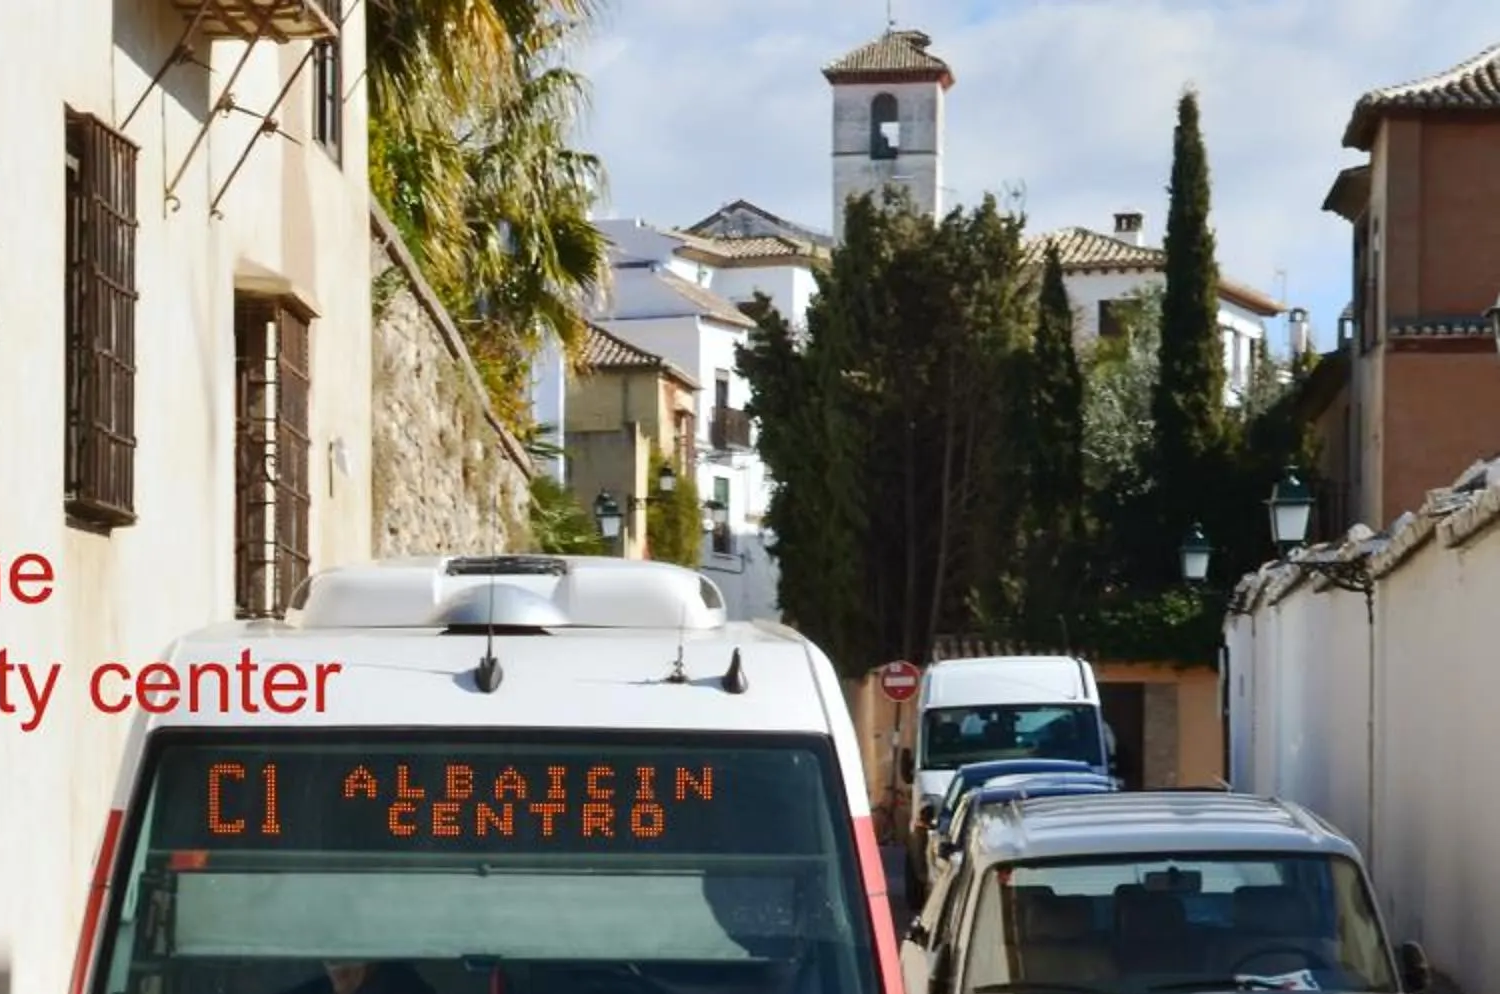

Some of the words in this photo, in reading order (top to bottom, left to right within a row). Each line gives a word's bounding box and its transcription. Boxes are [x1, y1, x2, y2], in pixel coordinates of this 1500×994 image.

[207, 763, 281, 835] C1
[341, 764, 714, 801] ALBAICIN
[386, 801, 666, 838] CENTRO
